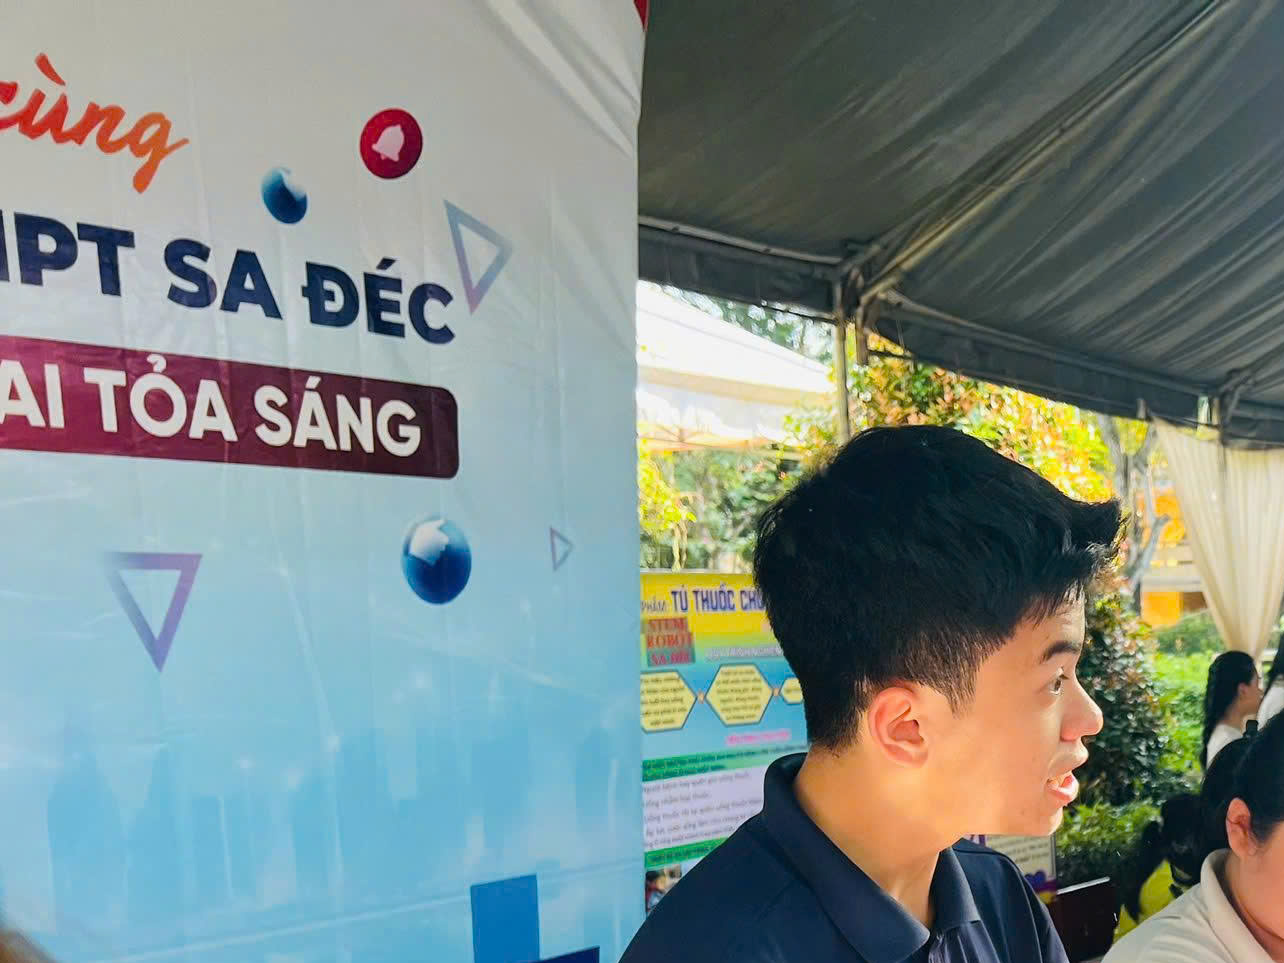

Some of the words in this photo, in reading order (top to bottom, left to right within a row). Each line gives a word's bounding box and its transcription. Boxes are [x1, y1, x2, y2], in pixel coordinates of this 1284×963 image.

[0, 209, 135, 297] PT
[164, 238, 283, 320] SA
[301, 257, 456, 344] ĐÉC
[83, 353, 238, 442] TỎA
[254, 376, 421, 457] SÁNG
[692, 580, 737, 611] THUỐC
